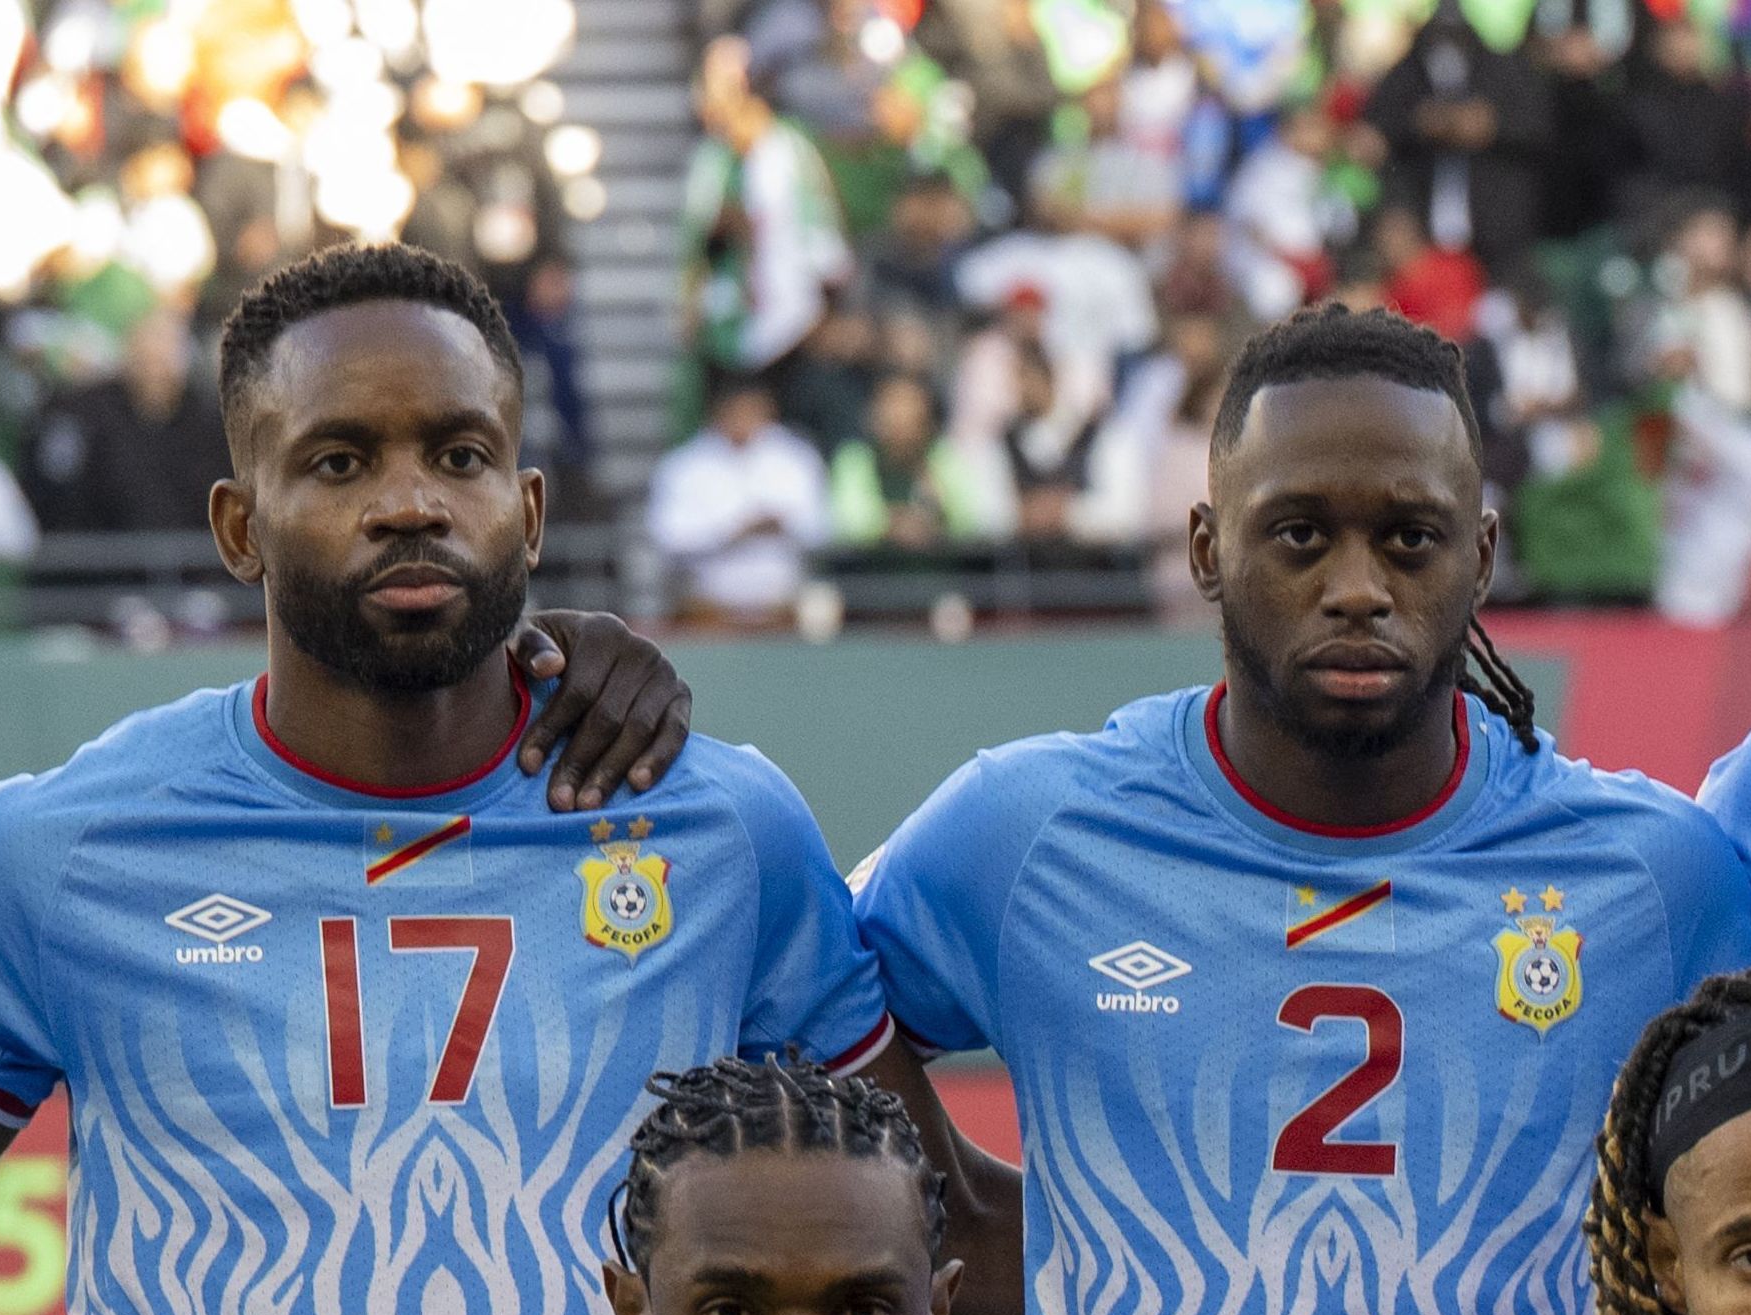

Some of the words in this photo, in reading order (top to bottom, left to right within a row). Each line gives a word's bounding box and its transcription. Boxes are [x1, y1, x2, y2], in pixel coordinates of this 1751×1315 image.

[601, 922, 661, 945] FECOFA
[175, 944, 263, 964] umbro
[319, 914, 515, 1110] 17
[1097, 991, 1179, 1013] umbro
[1514, 998, 1571, 1018] FECOFA
[1271, 981, 1405, 1177] 2
